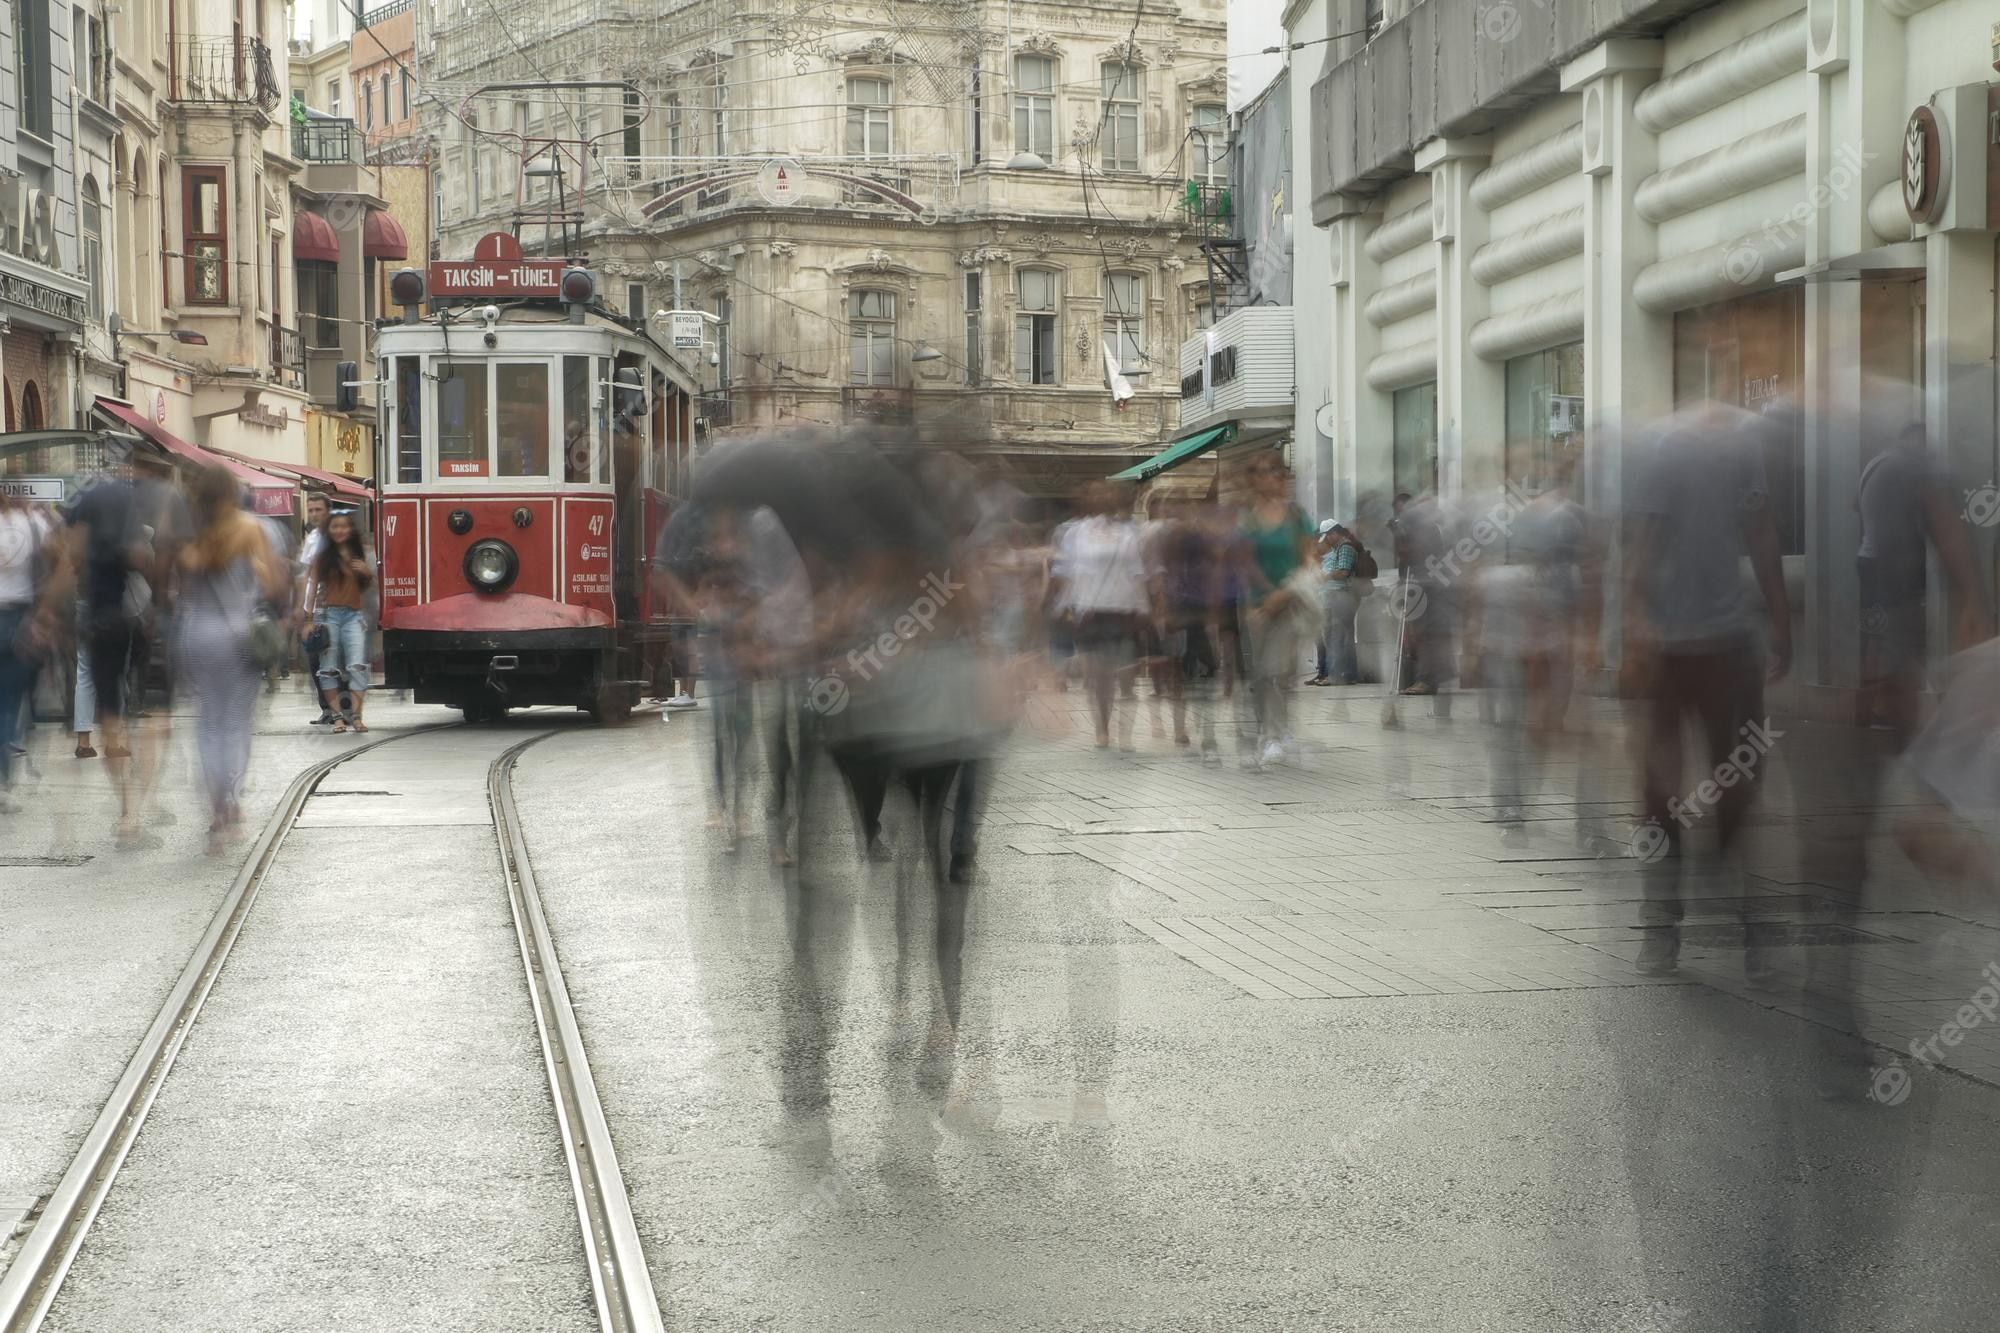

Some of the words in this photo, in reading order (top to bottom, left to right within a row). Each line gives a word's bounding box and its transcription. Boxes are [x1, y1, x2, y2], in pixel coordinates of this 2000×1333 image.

[494, 236, 500, 257] 1
[443, 266, 494, 287] TAKSİM
[510, 265, 558, 287] TÜNEL
[450, 463, 479, 473] TAKSİM
[386, 516, 397, 536] 47
[588, 515, 603, 536] 47
[572, 585, 581, 593] VE
